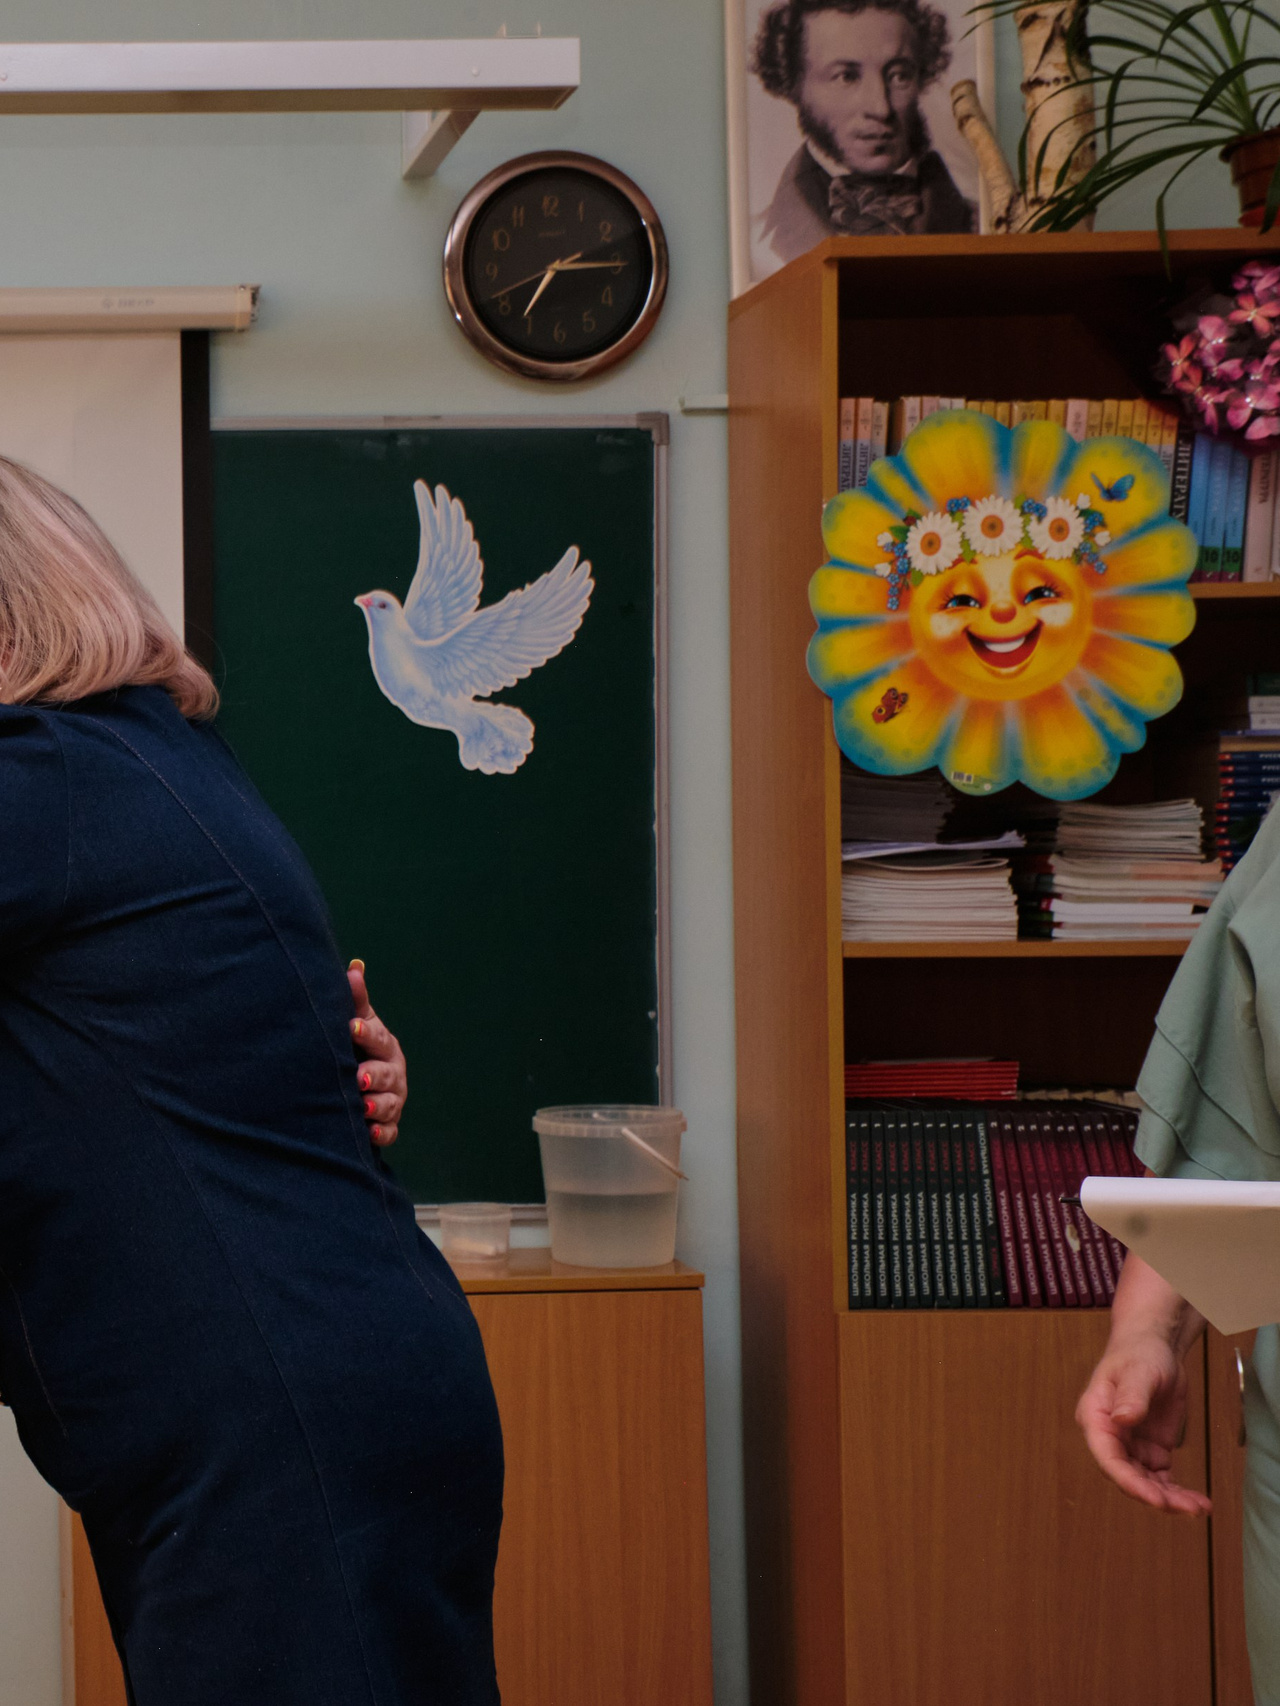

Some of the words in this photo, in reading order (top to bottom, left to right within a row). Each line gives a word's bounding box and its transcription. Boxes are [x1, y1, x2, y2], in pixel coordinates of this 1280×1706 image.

[511, 206, 525, 228] 11
[542, 194, 559, 218] 12
[577, 201, 585, 221] 1
[492, 230, 510, 251] 10
[599, 221, 612, 242] 2
[485, 263, 498, 281] 9
[499, 294, 511, 316] 8
[601, 287, 613, 306] 4
[553, 322, 566, 345] 6
[582, 311, 596, 333] 5
[1205, 550, 1219, 562] 10
[1226, 550, 1240, 563] 10
[874, 1141, 882, 1171] КЛАСС
[888, 1141, 896, 1171] КЛАСС
[901, 1141, 909, 1171] КЛАСС
[914, 1140, 922, 1171] КЛАСС
[928, 1141, 936, 1171] КЛАСС
[941, 1141, 949, 1171] КЛАСС
[954, 1141, 963, 1171] КЛАСС
[967, 1141, 976, 1171] КЛАСС
[977, 1123, 989, 1175] ШКОЛЬНАЯ
[983, 1179, 994, 1226] РИТОРИКА
[876, 1193, 884, 1240] РИТОРИКА
[890, 1193, 899, 1241] РИТОРИКА
[904, 1193, 912, 1240] РИТОРИКА
[917, 1192, 926, 1239] РИТОРИКА
[931, 1193, 940, 1240] РИТОРИКА
[944, 1192, 954, 1240] РИТОРИКА
[958, 1193, 968, 1240] РИТОРИКА
[971, 1192, 982, 1240] РИТОРИКА
[999, 1190, 1010, 1237] РИТОРИКА
[1016, 1192, 1029, 1239] РИТОРИКА
[1032, 1193, 1046, 1240] РИТОРИКА
[1045, 1192, 1060, 1239] РИТОРИКА
[851, 1244, 859, 1296] ШКОЛЬНАЯ
[863, 1244, 871, 1296] ШКОЛЬНАЯ
[878, 1244, 887, 1296] ШКОЛЬНАЯ
[892, 1245, 902, 1297] ШКОЛЬНАЯ
[906, 1245, 916, 1296] ШКОЛЬНАЯ
[919, 1243, 930, 1295] ШКОЛЬНАЯ
[934, 1244, 944, 1296] ШКОЛЬНАЯ
[948, 1244, 959, 1296] ШКОЛЬНАЯ
[961, 1245, 973, 1296] ШКОЛЬНАЯ
[976, 1244, 988, 1296] ШКОЛЬНАЯ
[1005, 1242, 1018, 1293] ШКОЛЬНАЯ
[1023, 1243, 1038, 1295] ШКОЛЬНАЯ
[1041, 1244, 1057, 1295] ШКОЛЬНАЯ
[1055, 1243, 1073, 1294] ШКОЛЬНАЯ
[1085, 1243, 1102, 1294] ШКОЛЬНАЯ
